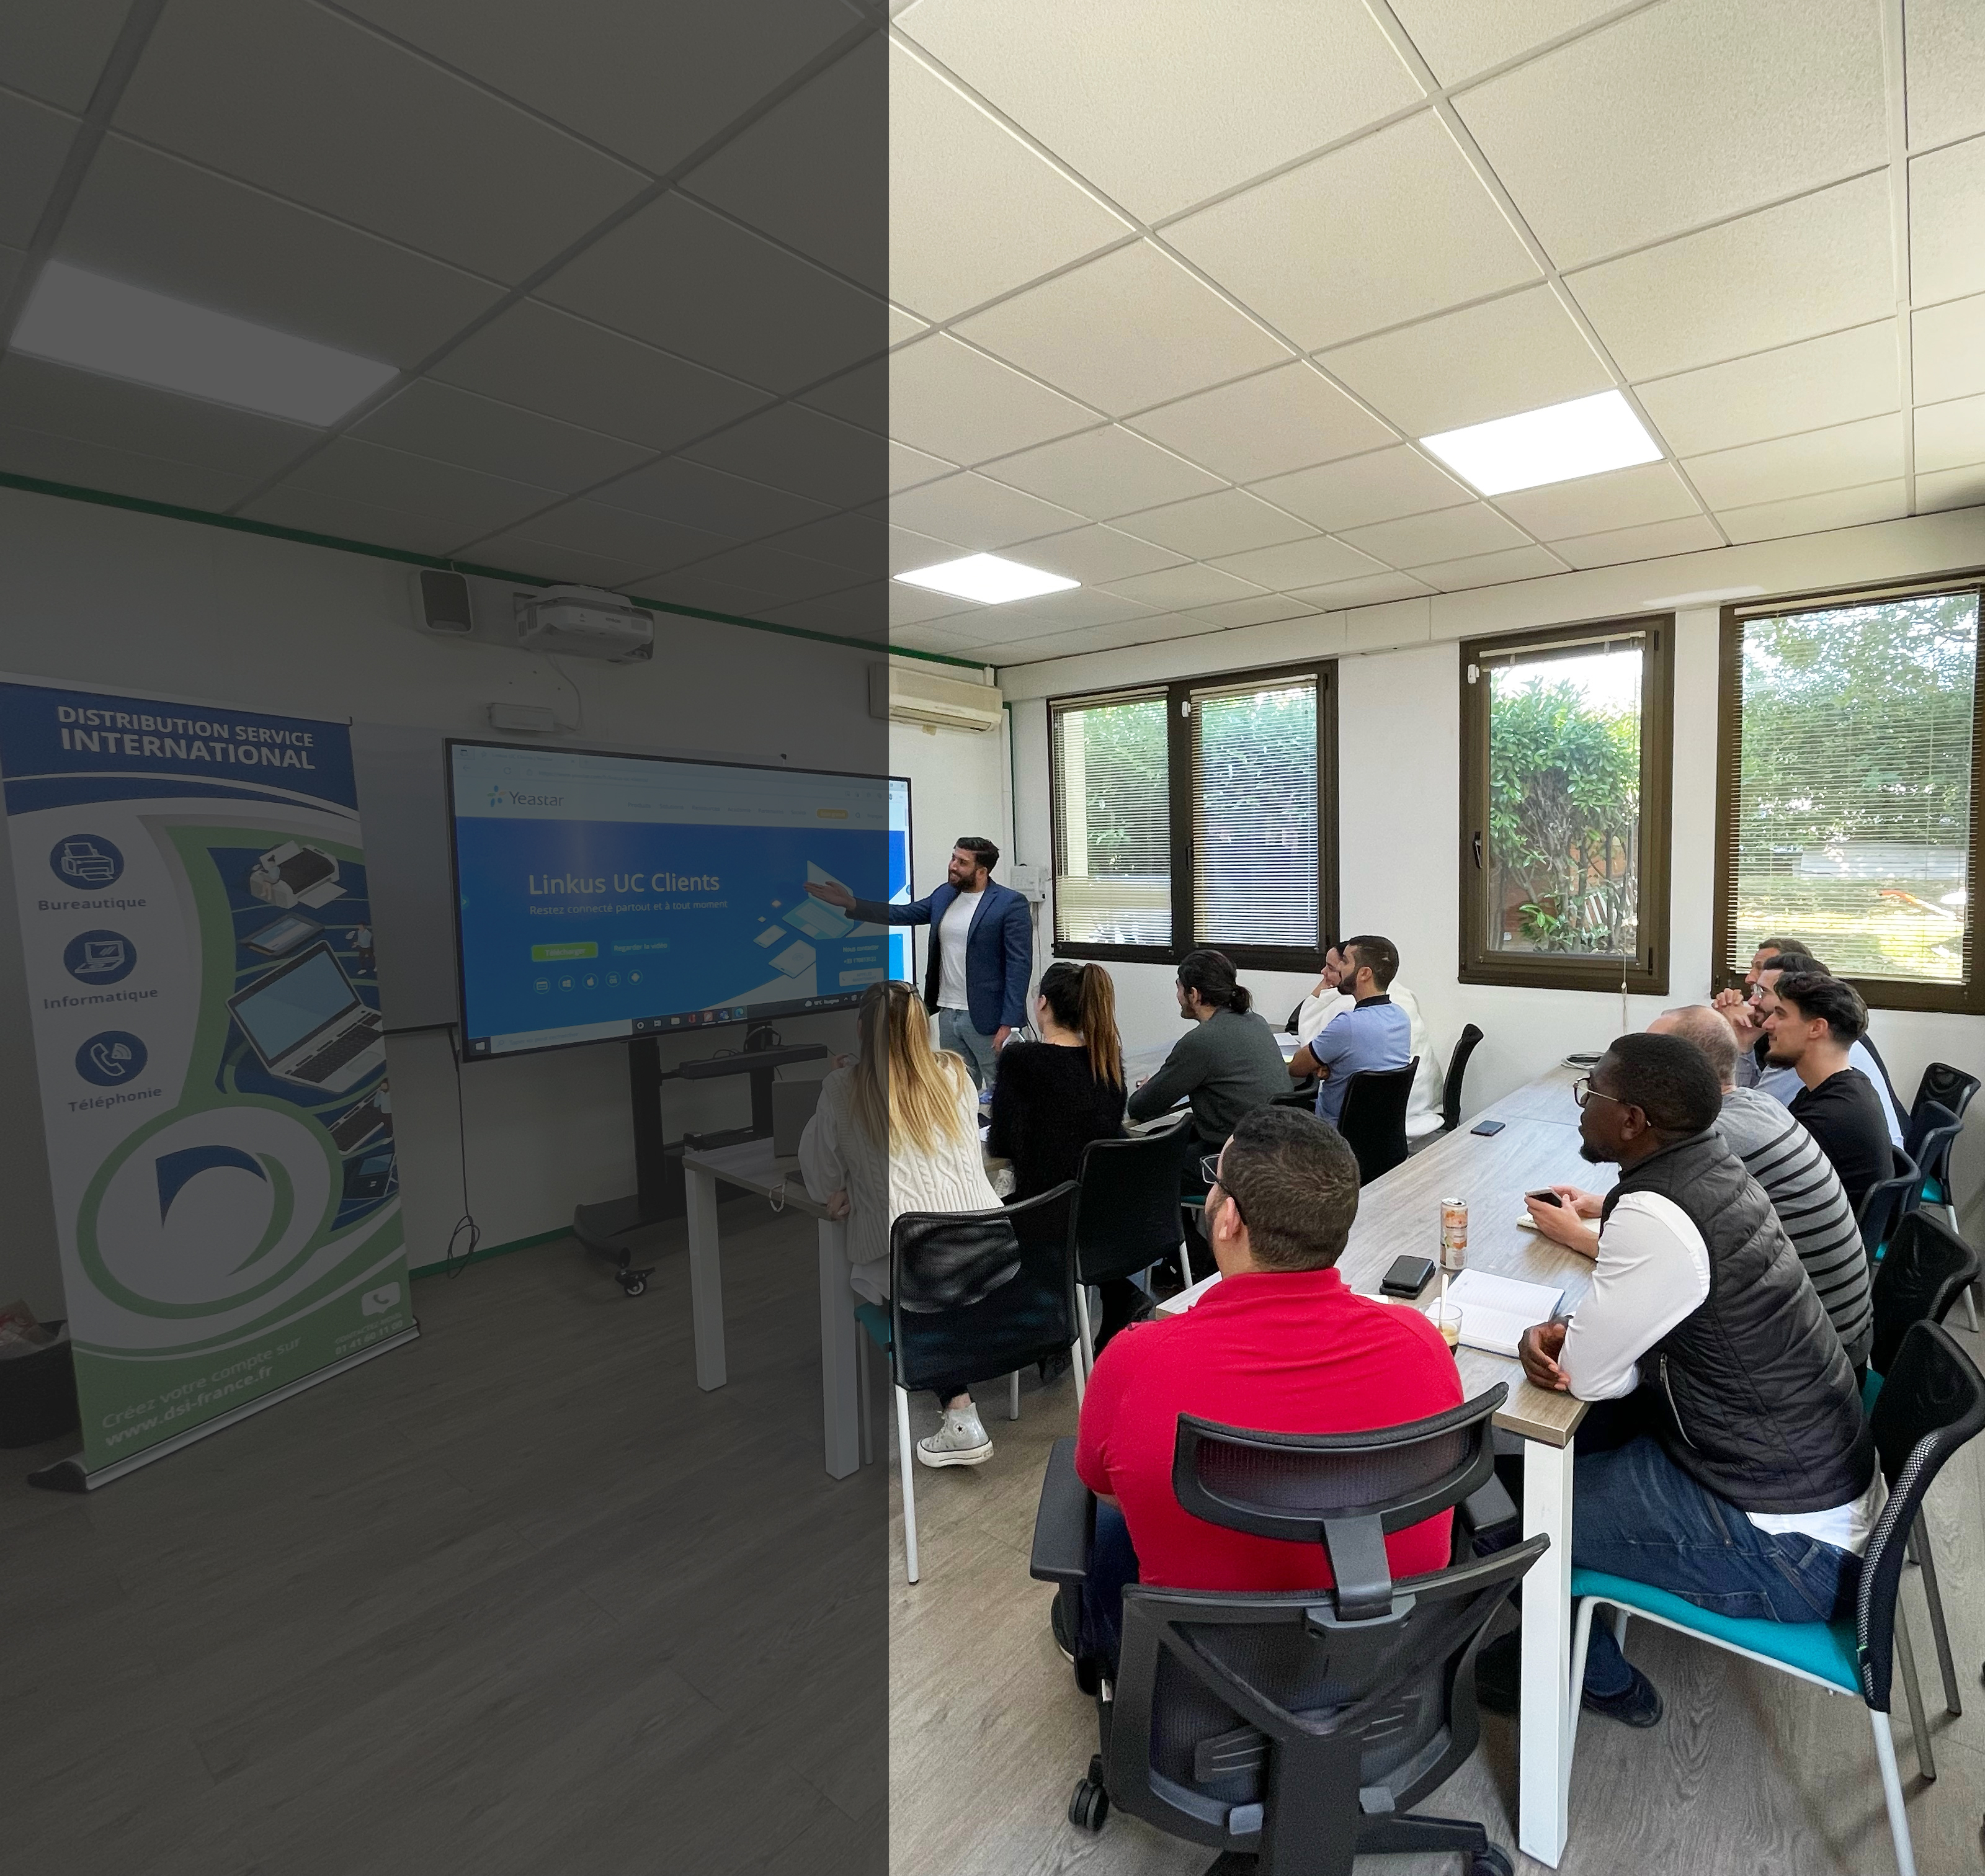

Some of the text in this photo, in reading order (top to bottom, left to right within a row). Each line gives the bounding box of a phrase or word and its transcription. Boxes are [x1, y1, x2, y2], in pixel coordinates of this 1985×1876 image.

[57, 705, 314, 748] DISTRIBUTION SERVICE
[61, 727, 316, 770] INTERNATIONAL
[509, 790, 564, 807] Yeastar
[529, 872, 720, 895] Linkus UC Clients
[38, 896, 147, 913] Bureautique
[530, 900, 728, 915] Restez connecté partout et à tout moment
[545, 948, 586, 957] Télécharger
[613, 943, 643, 953] Regarder
[651, 942, 668, 950] vidéo
[43, 987, 159, 1009] Informatique
[68, 1086, 163, 1113] Téléphonie
[336, 1344, 347, 1355] 01
[349, 1338, 362, 1348] 41
[391, 1320, 403, 1330] 00
[102, 1336, 301, 1428] Créez votre compte sur
[105, 1365, 273, 1447] www.dsi-france.fr
